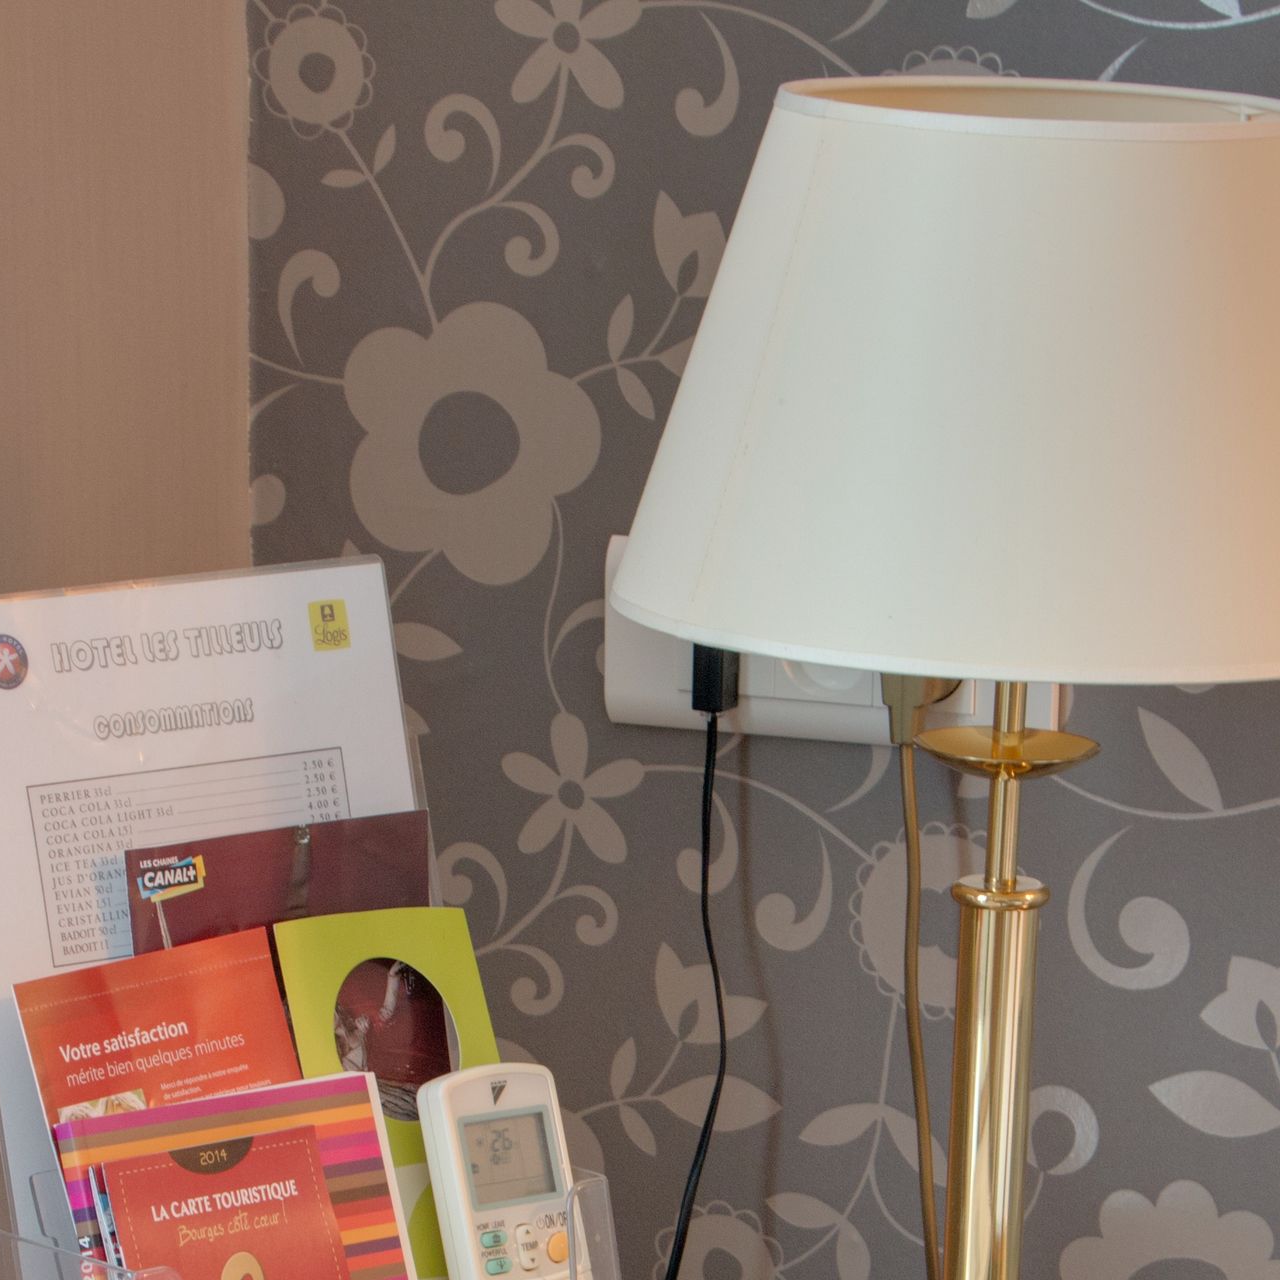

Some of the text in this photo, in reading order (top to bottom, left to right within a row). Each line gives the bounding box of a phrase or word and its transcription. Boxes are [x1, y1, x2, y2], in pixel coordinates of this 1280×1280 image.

[314, 624, 348, 647] Logis
[50, 618, 284, 674] HOTEL LES TILLEULS
[94, 697, 255, 740] CONSOMMATIONS
[39, 790, 91, 806] PERRIER
[41, 805, 76, 819] COCA
[79, 801, 112, 814] COLA
[44, 818, 78, 833] COCA
[81, 814, 113, 828] COLA
[117, 808, 155, 823] LIGHT
[46, 832, 79, 846] COCA
[83, 828, 116, 841] COLA
[48, 844, 114, 860] ORANGINA
[50, 861, 71, 874] ICE
[75, 857, 98, 871] TEA
[140, 859, 152, 869] LES
[52, 876, 73, 890] JUS
[144, 866, 196, 888] CANAL+
[55, 886, 92, 901] EVIAN
[57, 900, 94, 914] EVIAN
[60, 927, 97, 942] BADOIT
[63, 941, 99, 956] BADOIT
[59, 1021, 189, 1063] Votre satisfaction
[66, 1032, 245, 1088] mérite bien quelques minutes
[199, 1148, 228, 1166] 2014
[151, 1179, 299, 1222] LA CARTE TOURISTIQUE
[177, 1222, 224, 1248] Bourges
[227, 1209, 249, 1235] côté
[521, 1240, 539, 1253] TEMP
